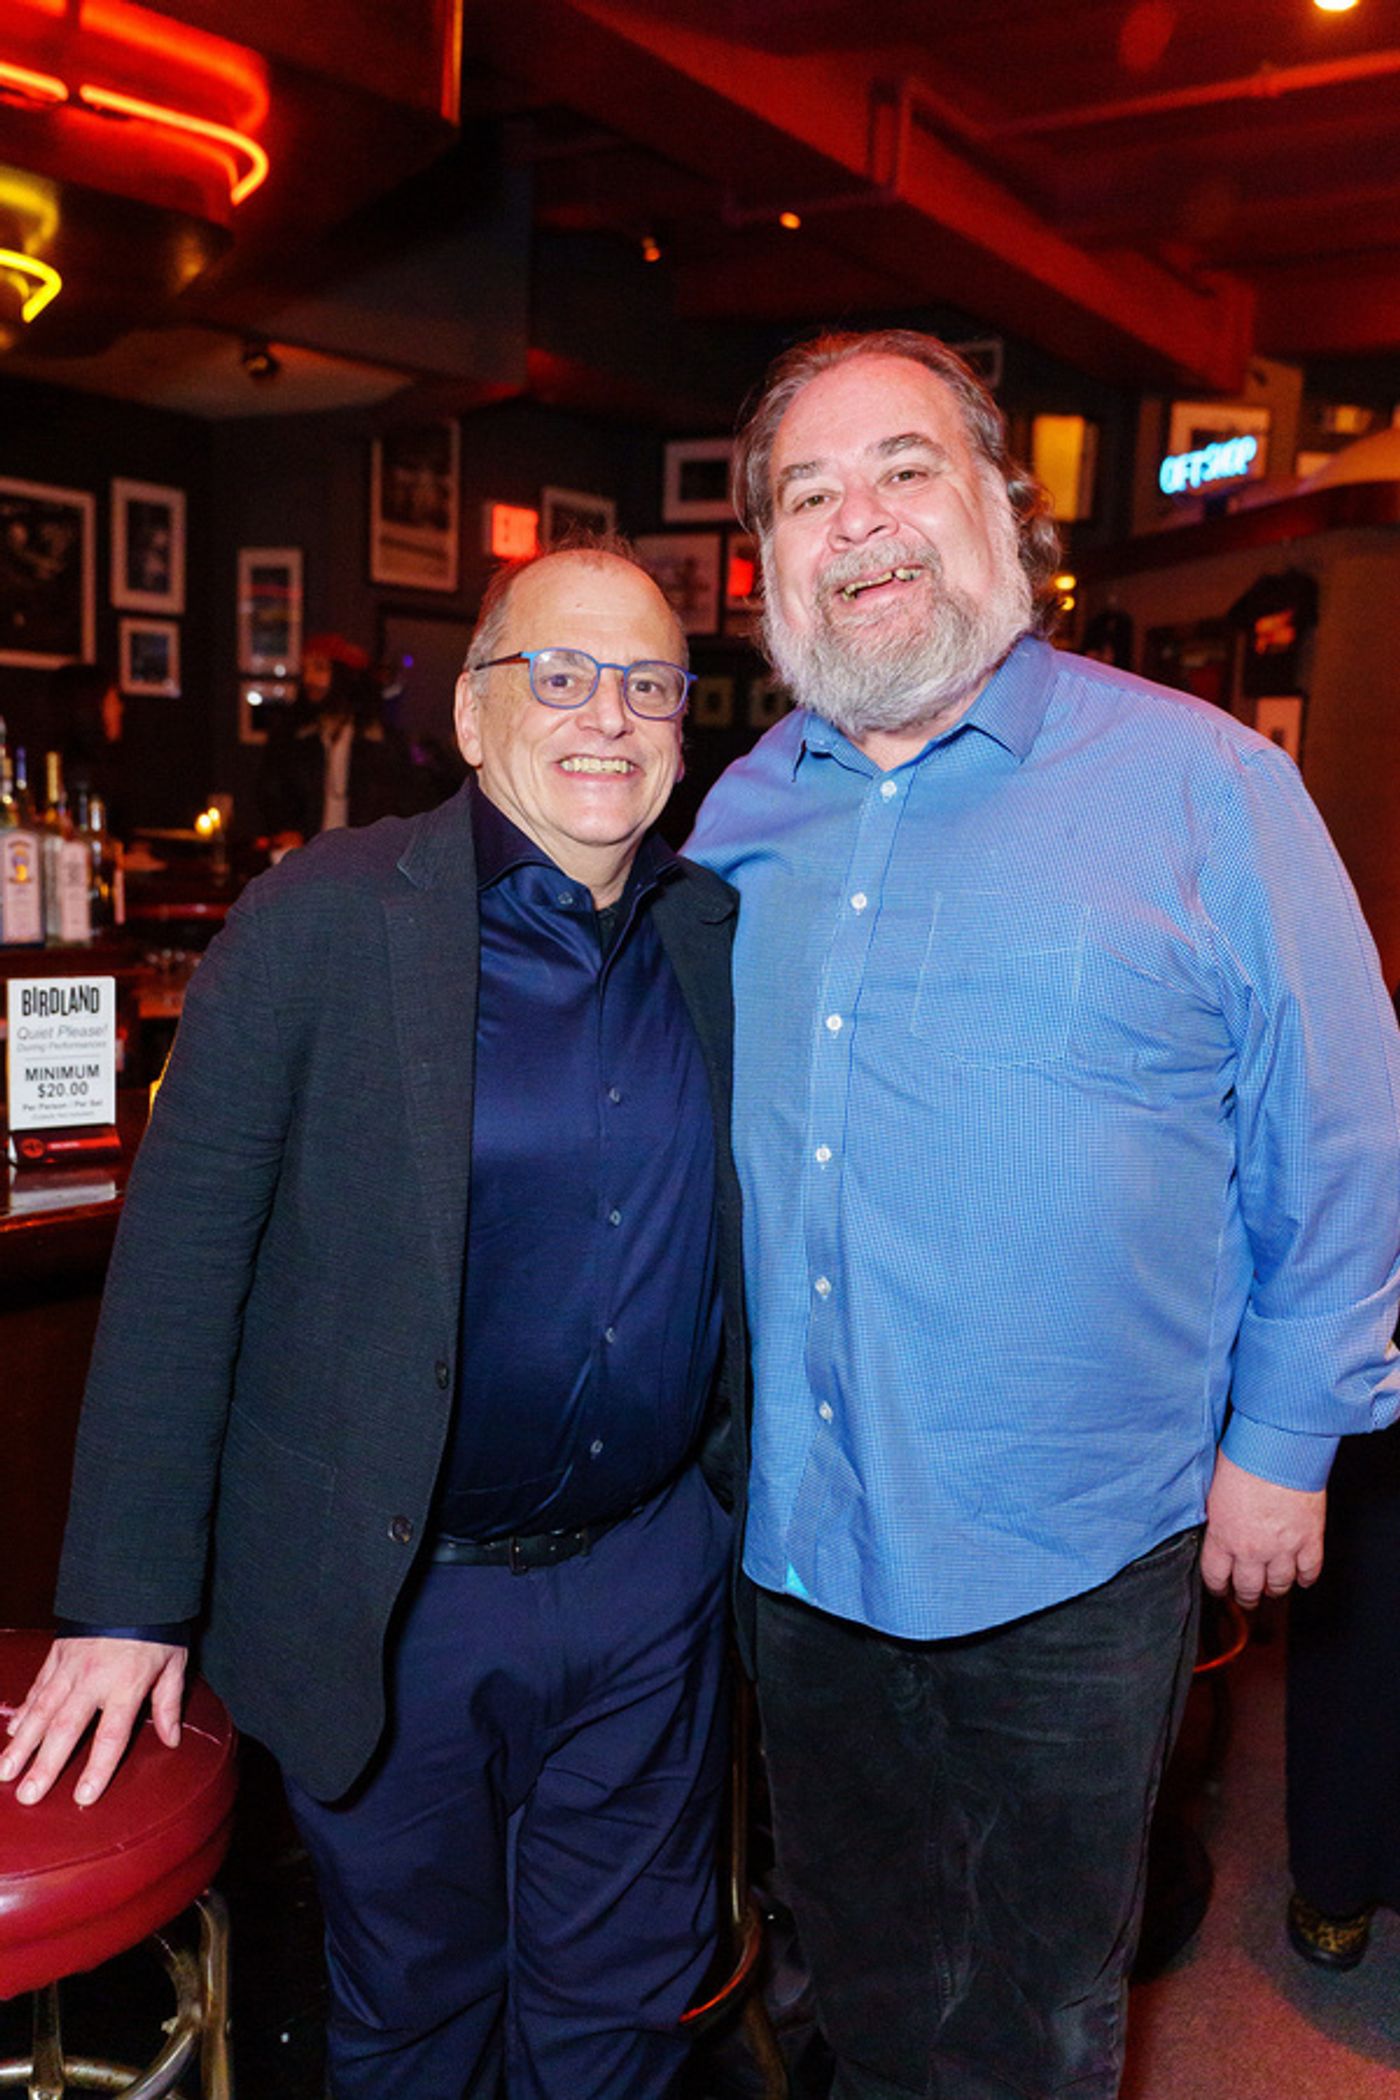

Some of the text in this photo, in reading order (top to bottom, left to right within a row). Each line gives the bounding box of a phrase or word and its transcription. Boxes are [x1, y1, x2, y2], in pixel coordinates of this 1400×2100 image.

[21, 985, 101, 1017] BIRDLAND
[17, 1024, 109, 1041] Quiet Please!
[25, 1064, 100, 1082] MINIMUM
[37, 1082, 89, 1098] $20.00
